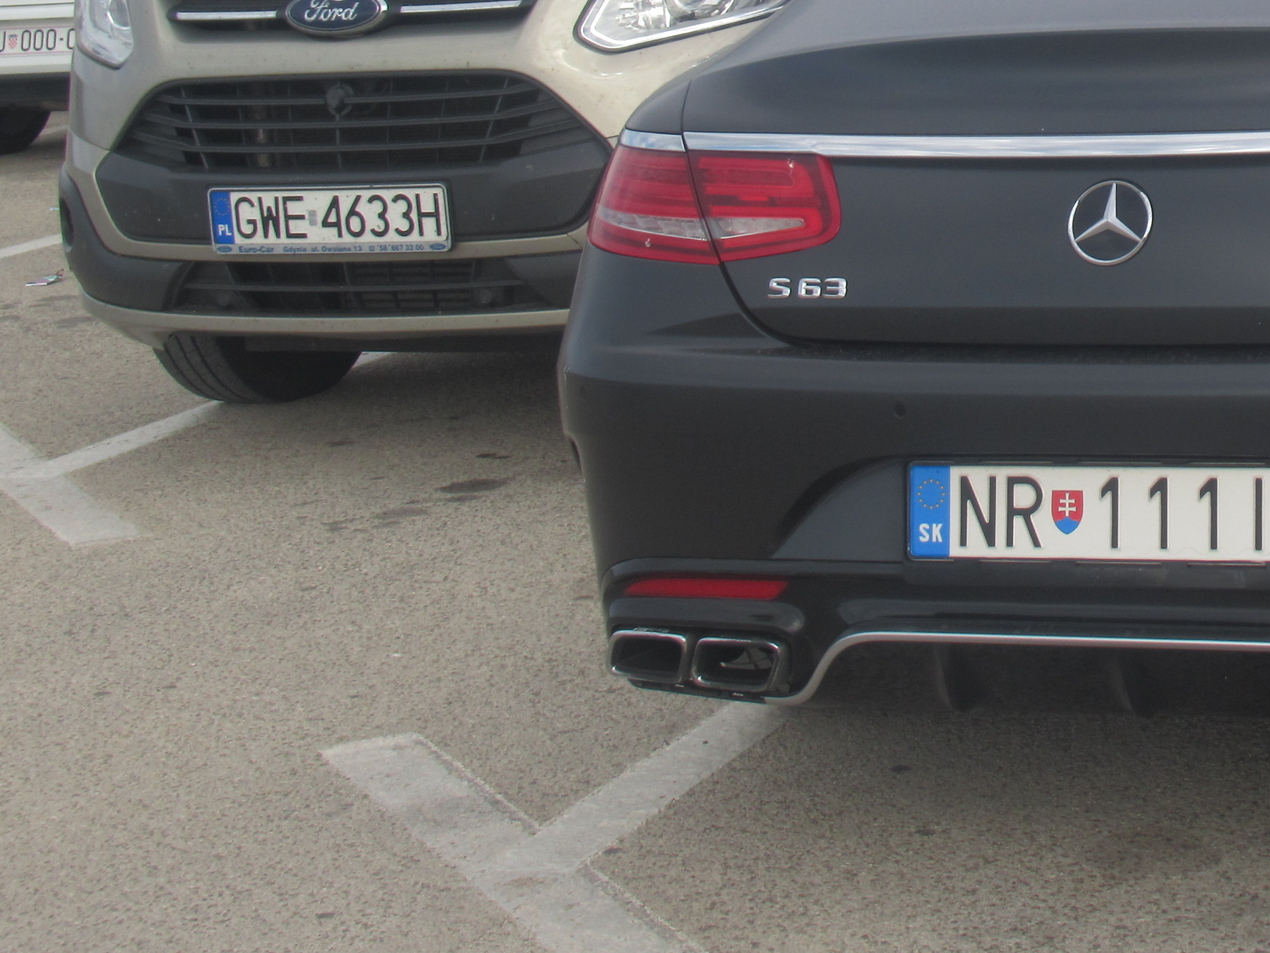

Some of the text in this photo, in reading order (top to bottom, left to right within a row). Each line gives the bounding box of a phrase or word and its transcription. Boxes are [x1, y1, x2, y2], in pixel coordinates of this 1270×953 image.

[234, 192, 443, 239] GWE 4633H
[218, 224, 232, 236] PL
[238, 245, 275, 253] Euro-Car
[767, 277, 848, 299] S 63
[959, 475, 1043, 548] NR
[919, 523, 943, 542] SK
